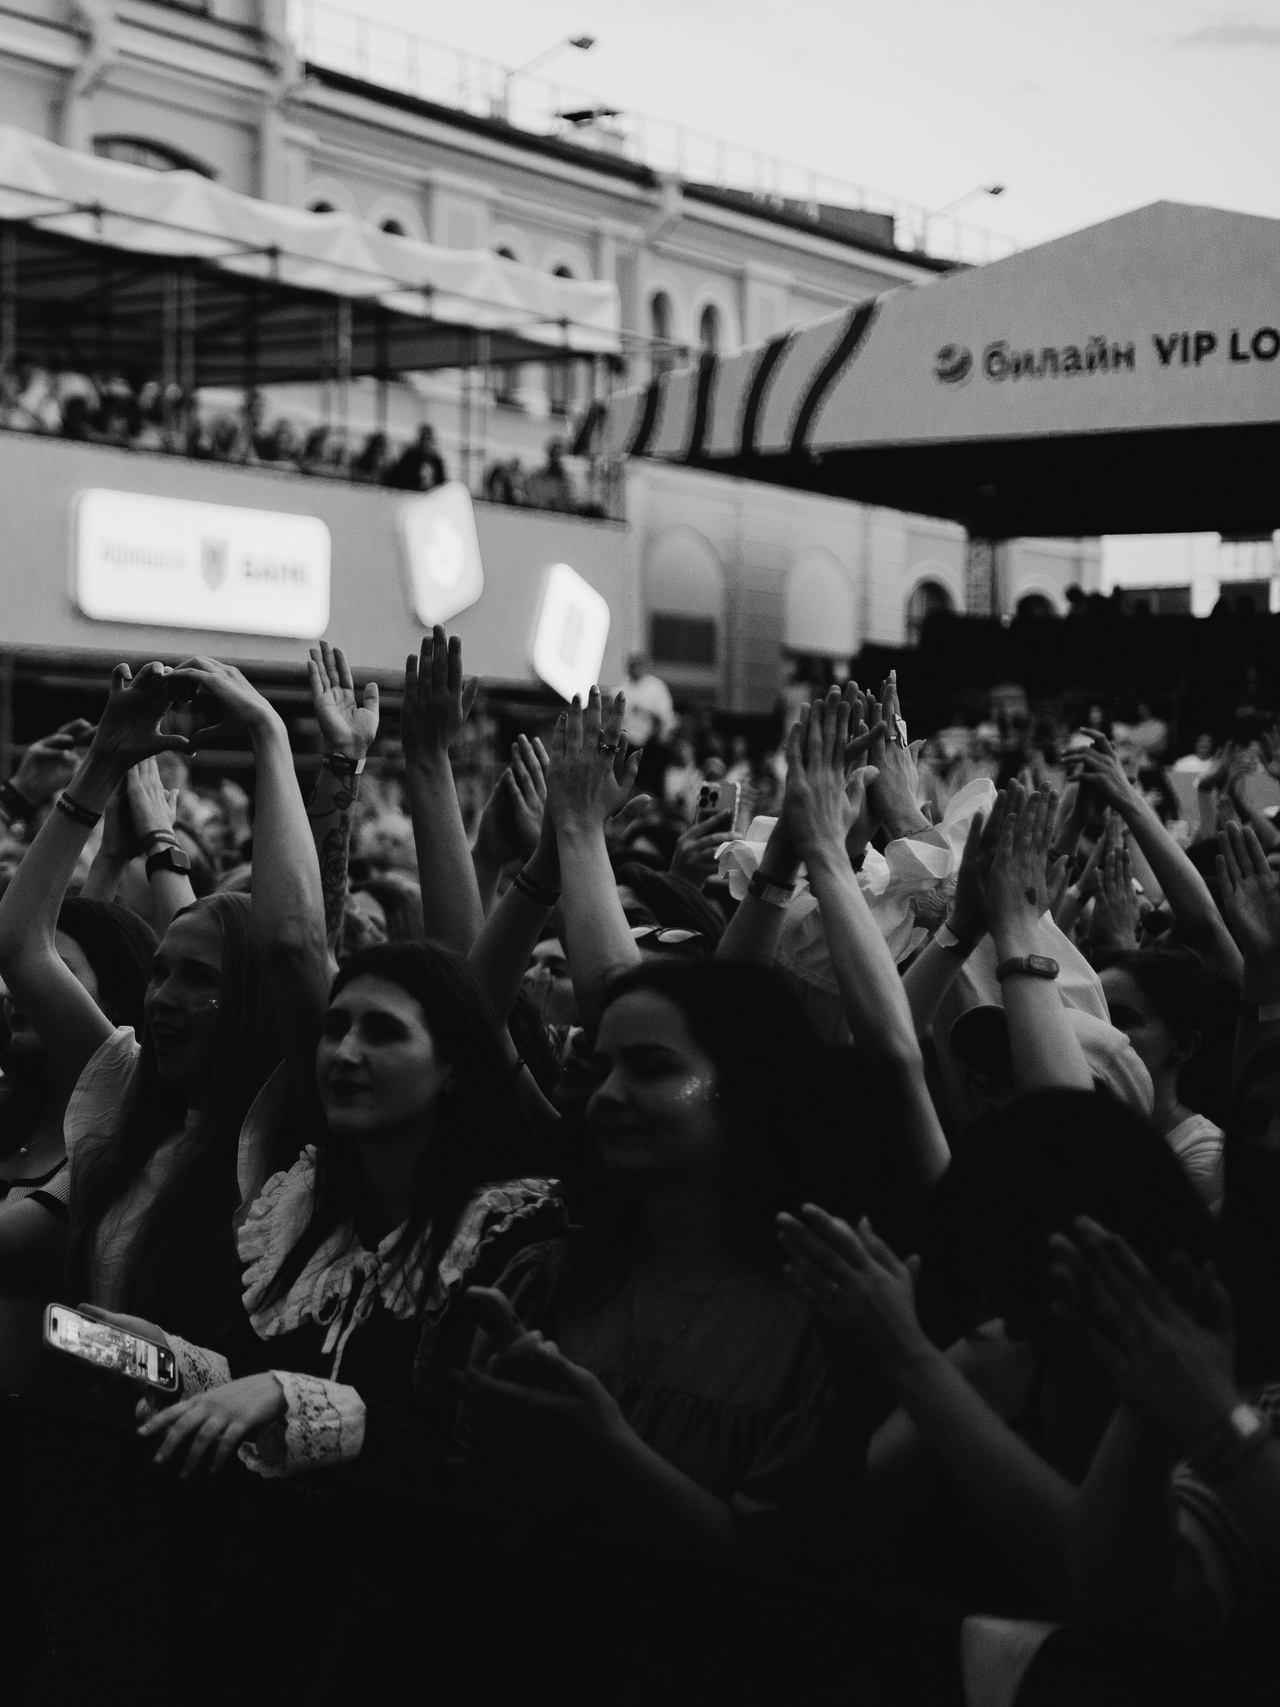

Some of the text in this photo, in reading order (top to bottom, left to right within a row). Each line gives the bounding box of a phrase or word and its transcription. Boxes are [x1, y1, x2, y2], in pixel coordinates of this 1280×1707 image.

[983, 326, 1280, 382] билайн VIP LO
